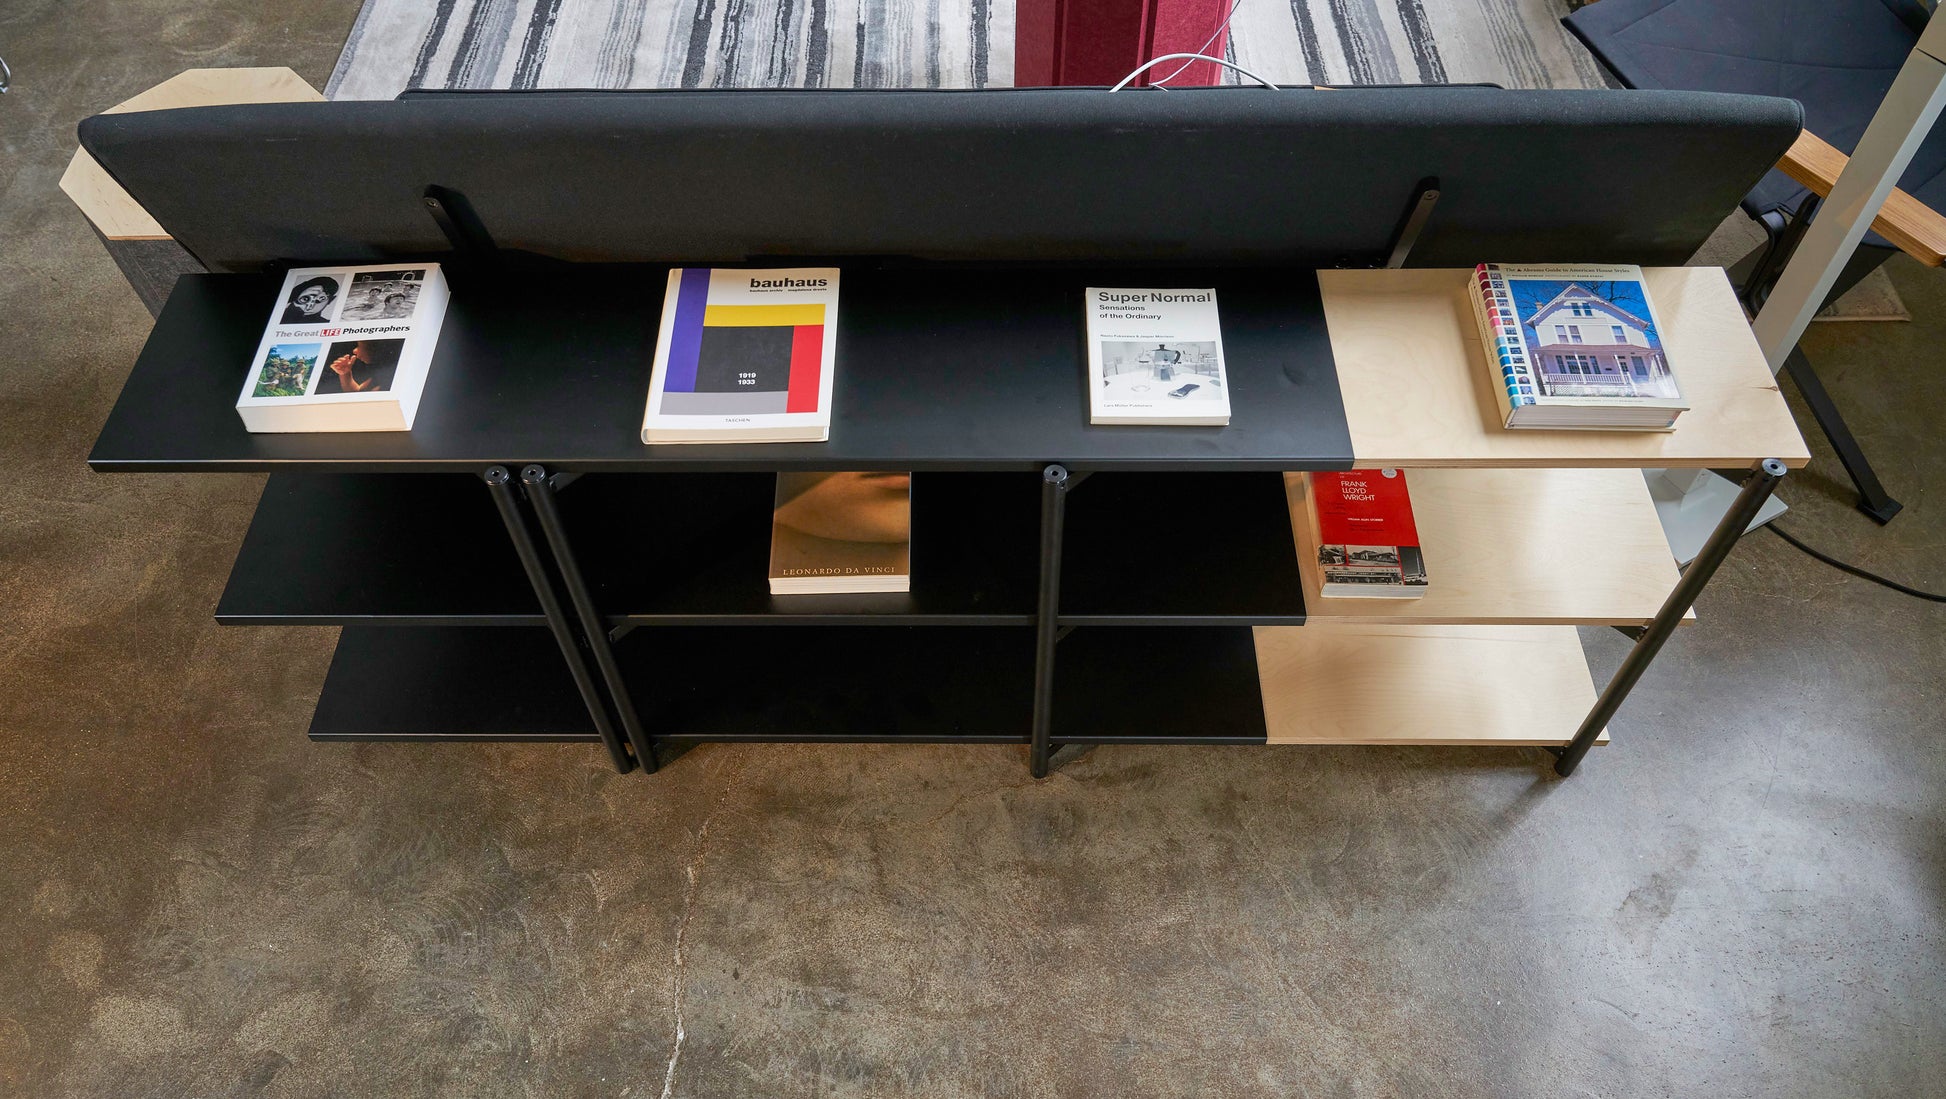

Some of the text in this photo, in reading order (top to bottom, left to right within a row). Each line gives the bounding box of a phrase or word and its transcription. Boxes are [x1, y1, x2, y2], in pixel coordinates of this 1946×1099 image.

[750, 278, 827, 288] bauhaus
[1099, 292, 1211, 304] Super Normal
[320, 328, 341, 337] LIFE
[342, 325, 410, 335] Photographers
